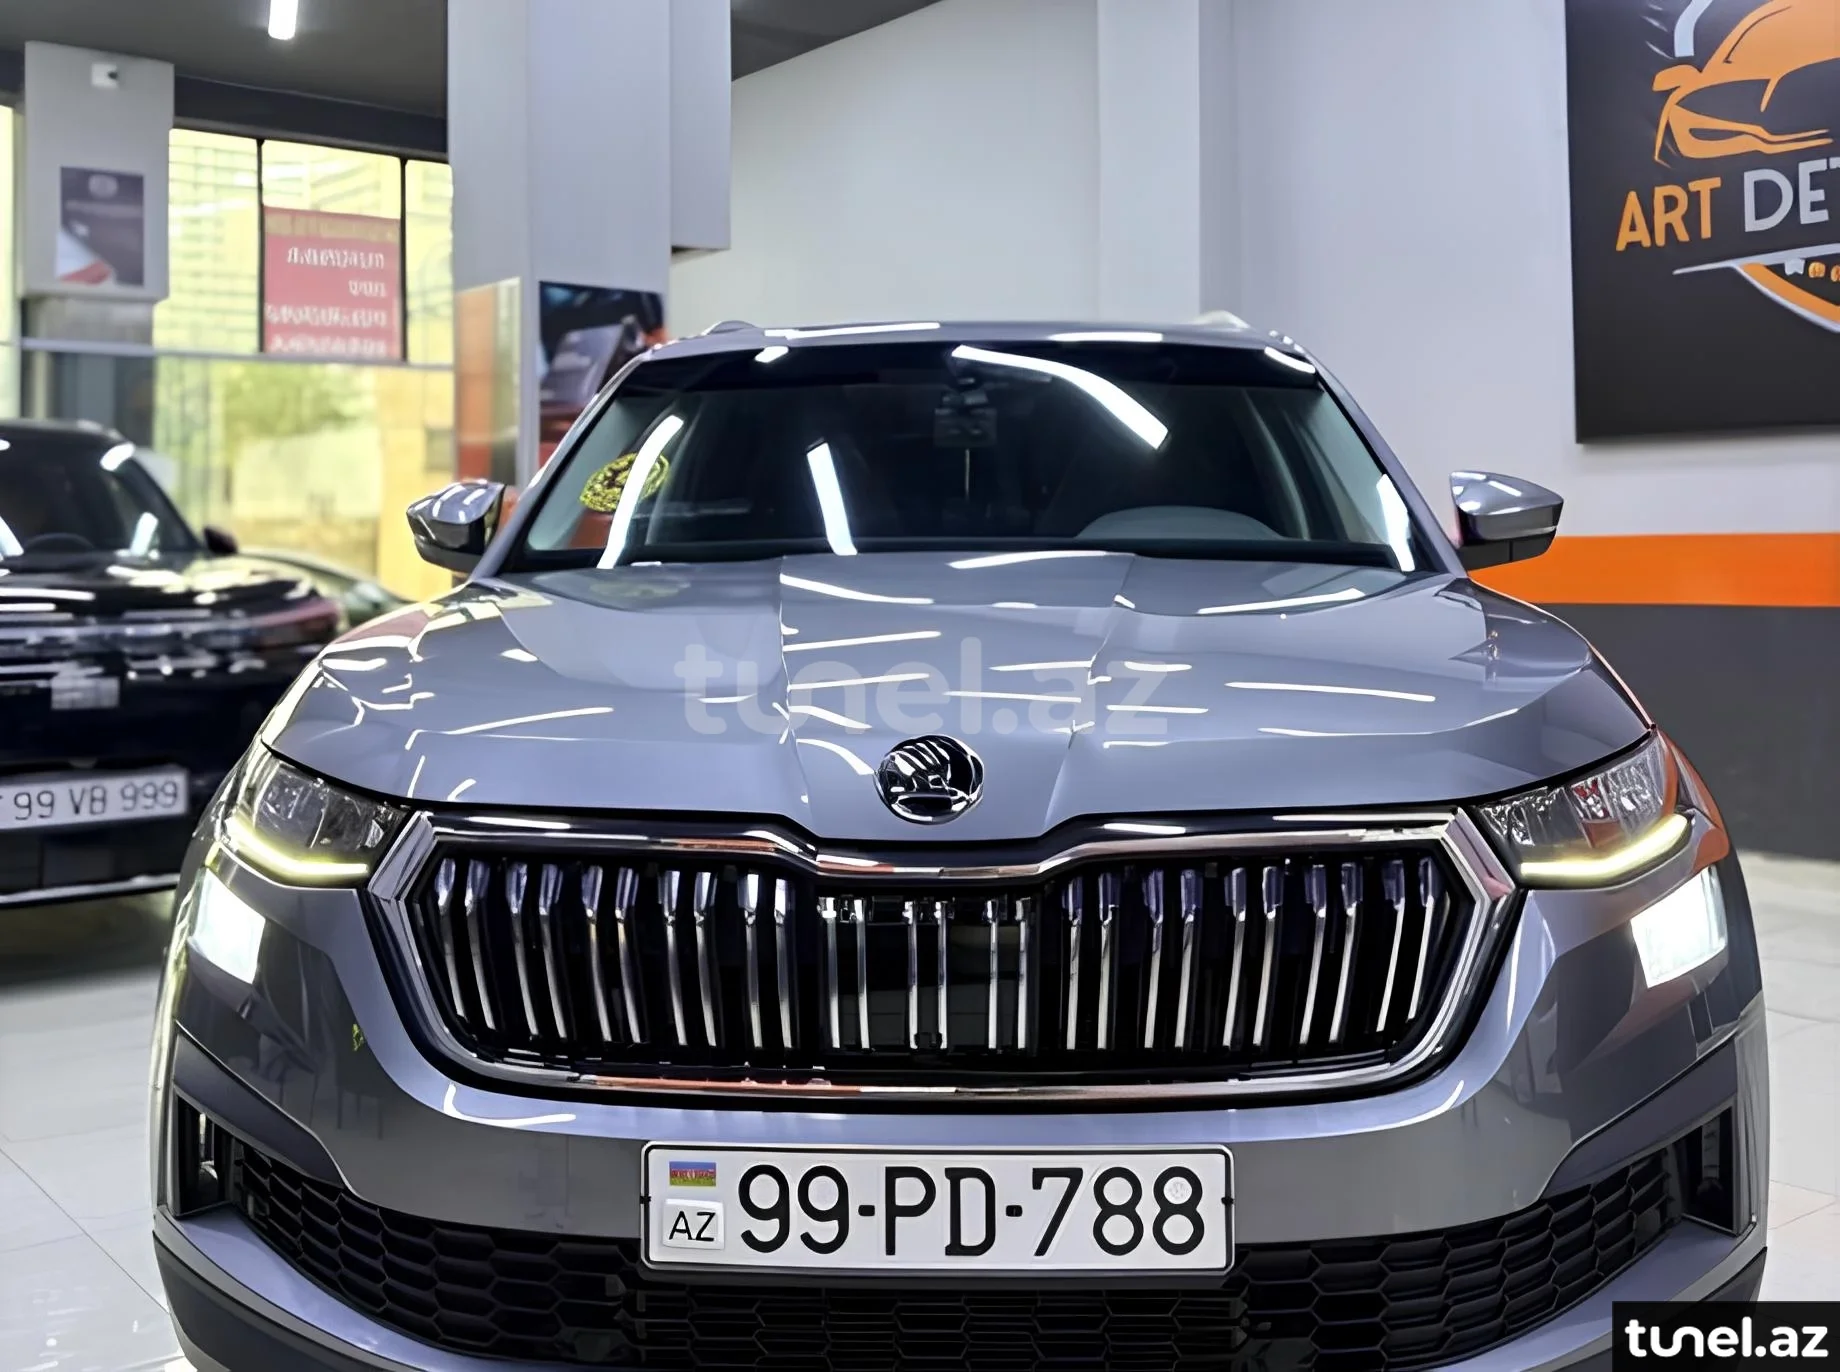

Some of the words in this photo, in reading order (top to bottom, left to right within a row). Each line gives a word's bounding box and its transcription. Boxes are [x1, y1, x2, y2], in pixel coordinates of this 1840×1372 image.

[1615, 176, 1722, 252] ART
[1743, 156, 1840, 233] DE
[13, 790, 55, 821] 99
[69, 784, 107, 816] VB
[120, 779, 178, 812] 999
[668, 1210, 716, 1242] AZ
[738, 1164, 1205, 1257] 99-PD-788
